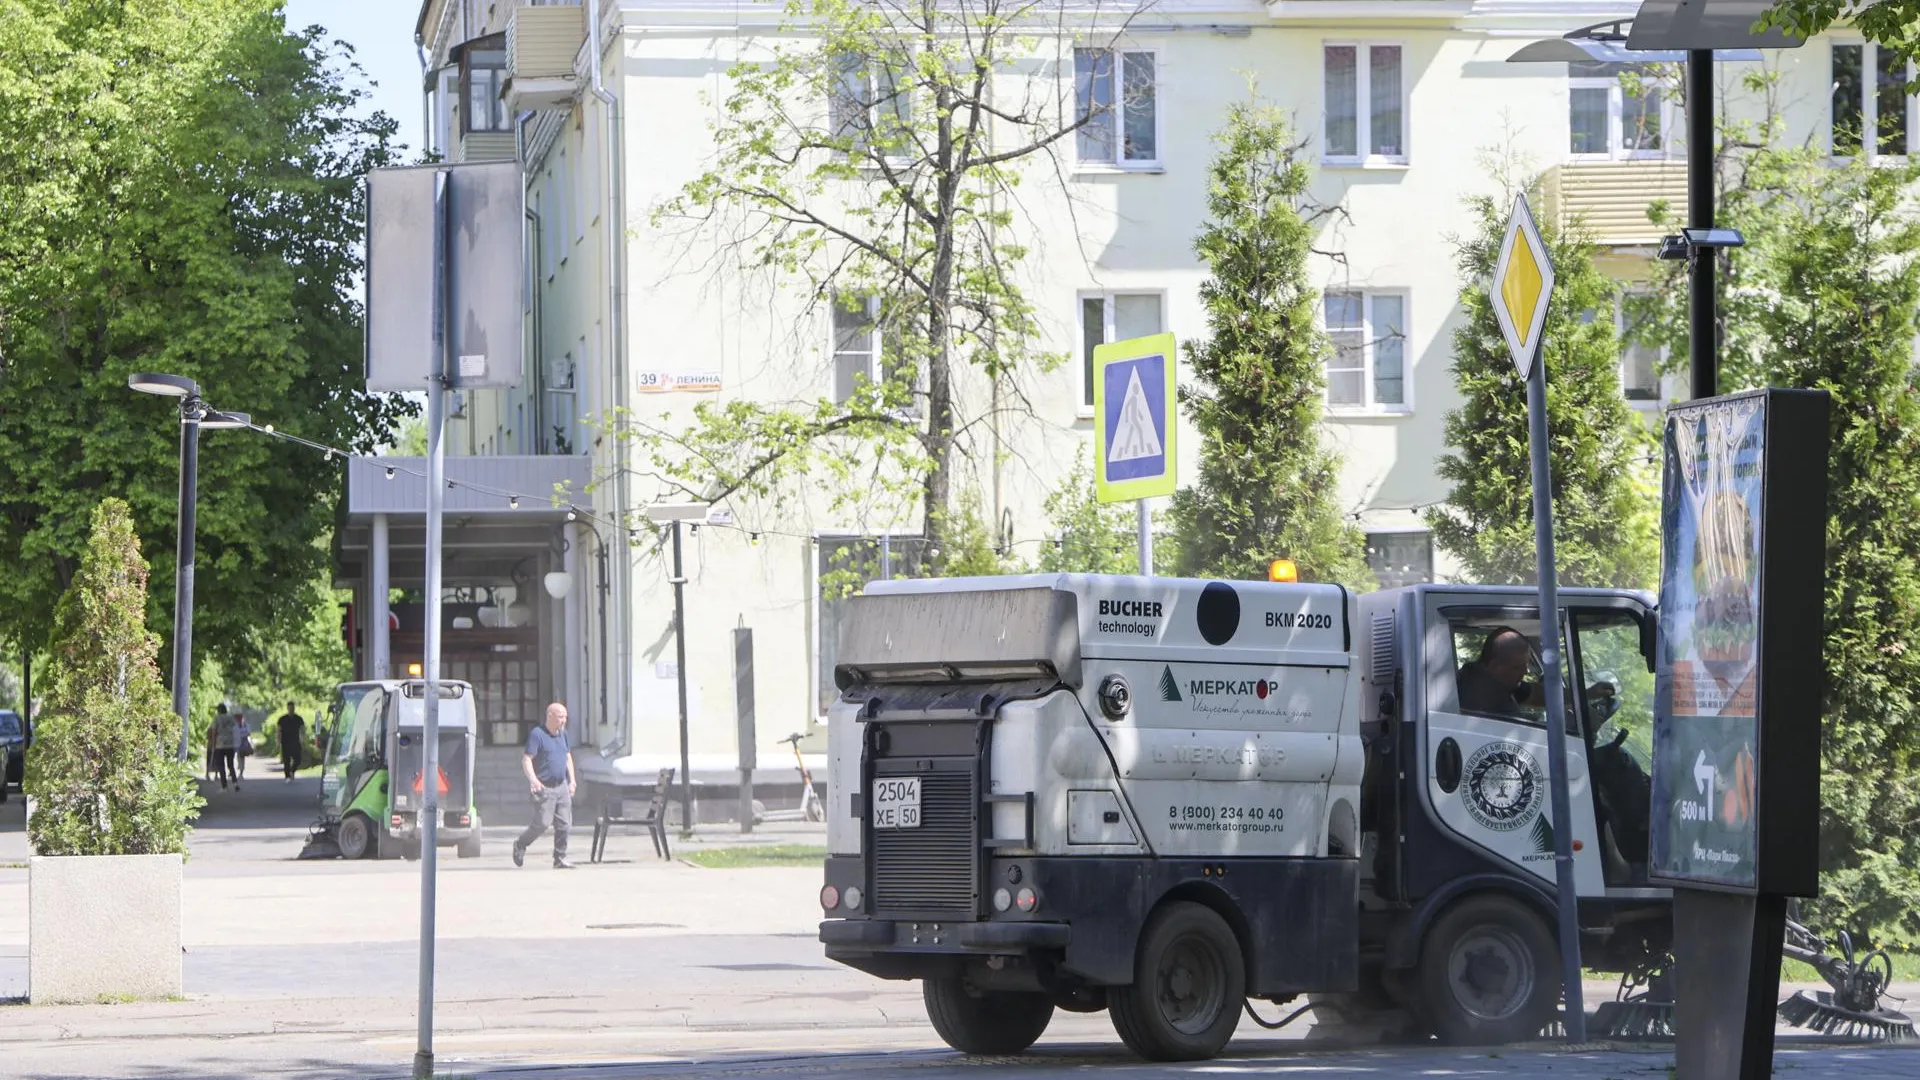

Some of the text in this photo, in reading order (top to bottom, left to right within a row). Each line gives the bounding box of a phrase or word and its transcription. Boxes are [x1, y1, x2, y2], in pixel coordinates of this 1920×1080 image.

[641, 373, 720, 385] 39 ЛЕНИНА
[1099, 600, 1163, 618] BUCHER
[1099, 621, 1156, 637] technology
[1297, 614, 1332, 629] 2020
[1190, 679, 1279, 699] МЕРКАТОР
[1172, 744, 1286, 766] МЕРКАТОР
[879, 781, 915, 801] 2504
[877, 808, 917, 825] ХЕ 50
[1169, 806, 1177, 818] 8
[1220, 807, 1244, 819] 234
[1248, 808, 1264, 820] 40
[1268, 808, 1284, 820] 40
[1681, 801, 1698, 820] 500
[1169, 822, 1284, 833] www.merkatorgroup.ru
[1522, 854, 1556, 862] МЕРКАТ
